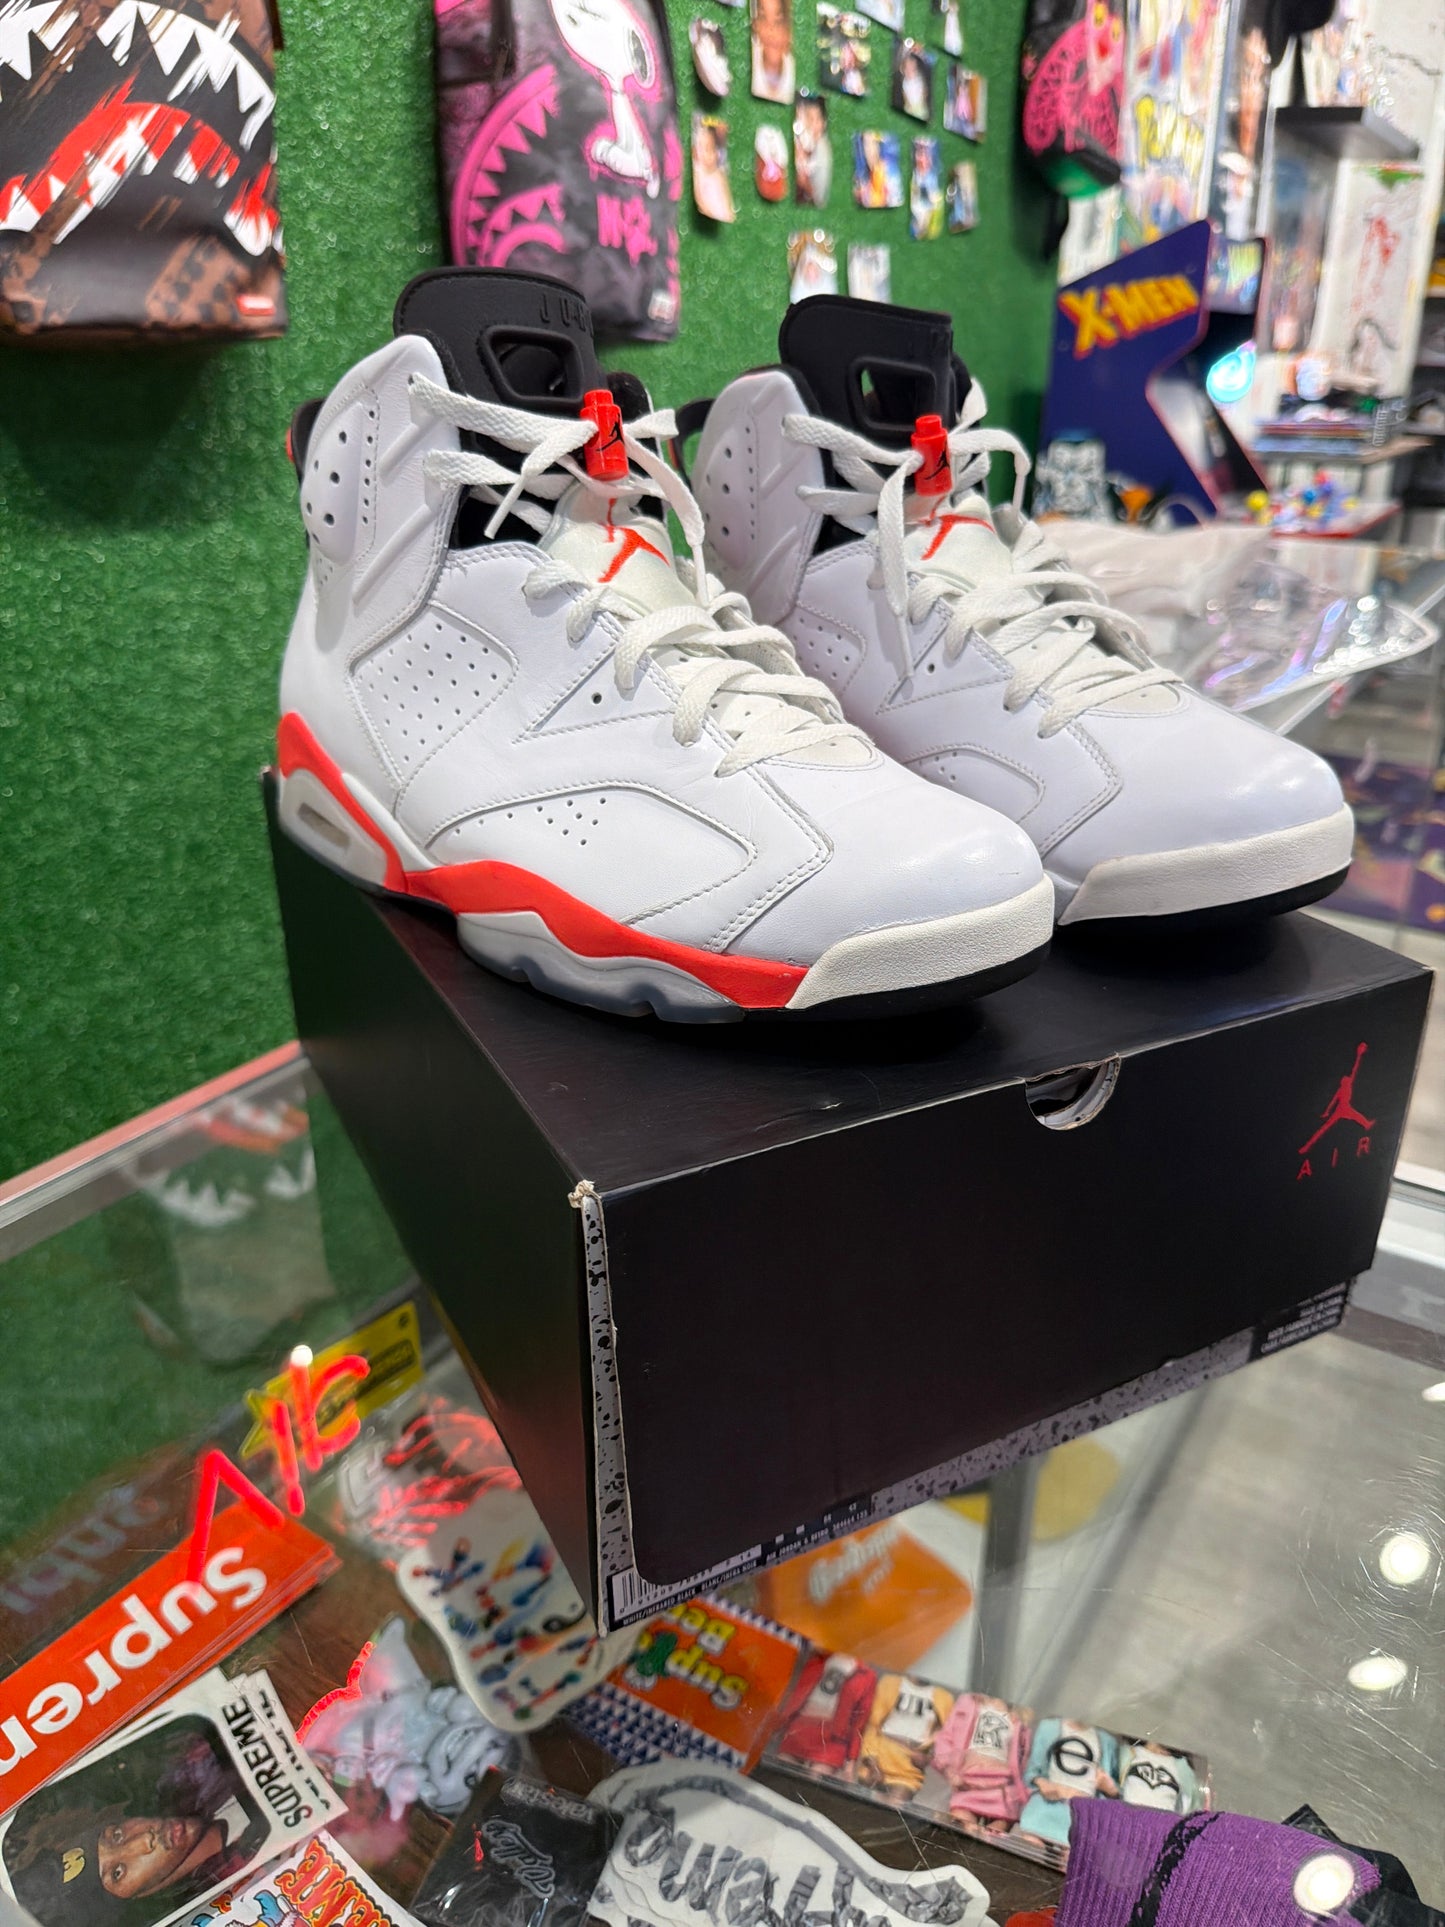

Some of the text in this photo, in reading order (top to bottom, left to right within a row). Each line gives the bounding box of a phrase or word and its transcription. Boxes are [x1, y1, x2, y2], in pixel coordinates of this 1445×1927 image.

[1058, 273, 1199, 361] X-MEN
[1296, 1136, 1370, 1182] AIR
[780, 1540, 801, 1556] JORDAN
[676, 1587, 697, 1604] BLACK
[741, 1559, 758, 1573] NOIR
[222, 1694, 314, 1829] SUPREME
